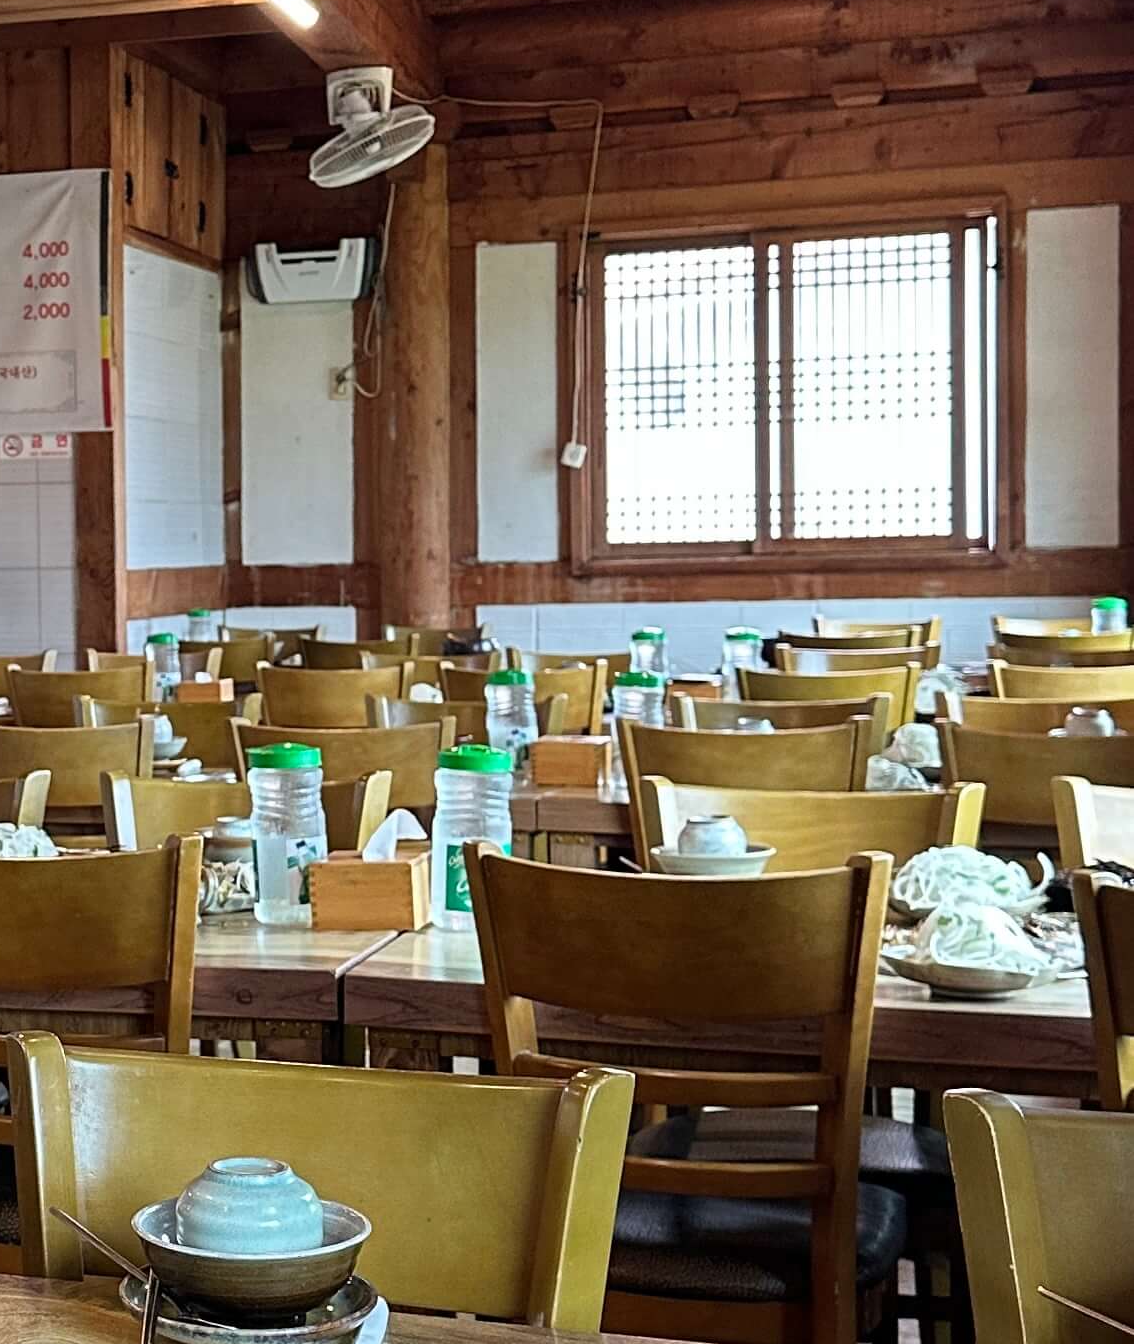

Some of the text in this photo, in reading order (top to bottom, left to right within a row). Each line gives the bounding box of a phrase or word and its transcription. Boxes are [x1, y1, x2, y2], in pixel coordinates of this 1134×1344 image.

[23, 240, 69, 260] 4,000
[23, 272, 70, 290] 4,000
[22, 302, 70, 321] 2,000
